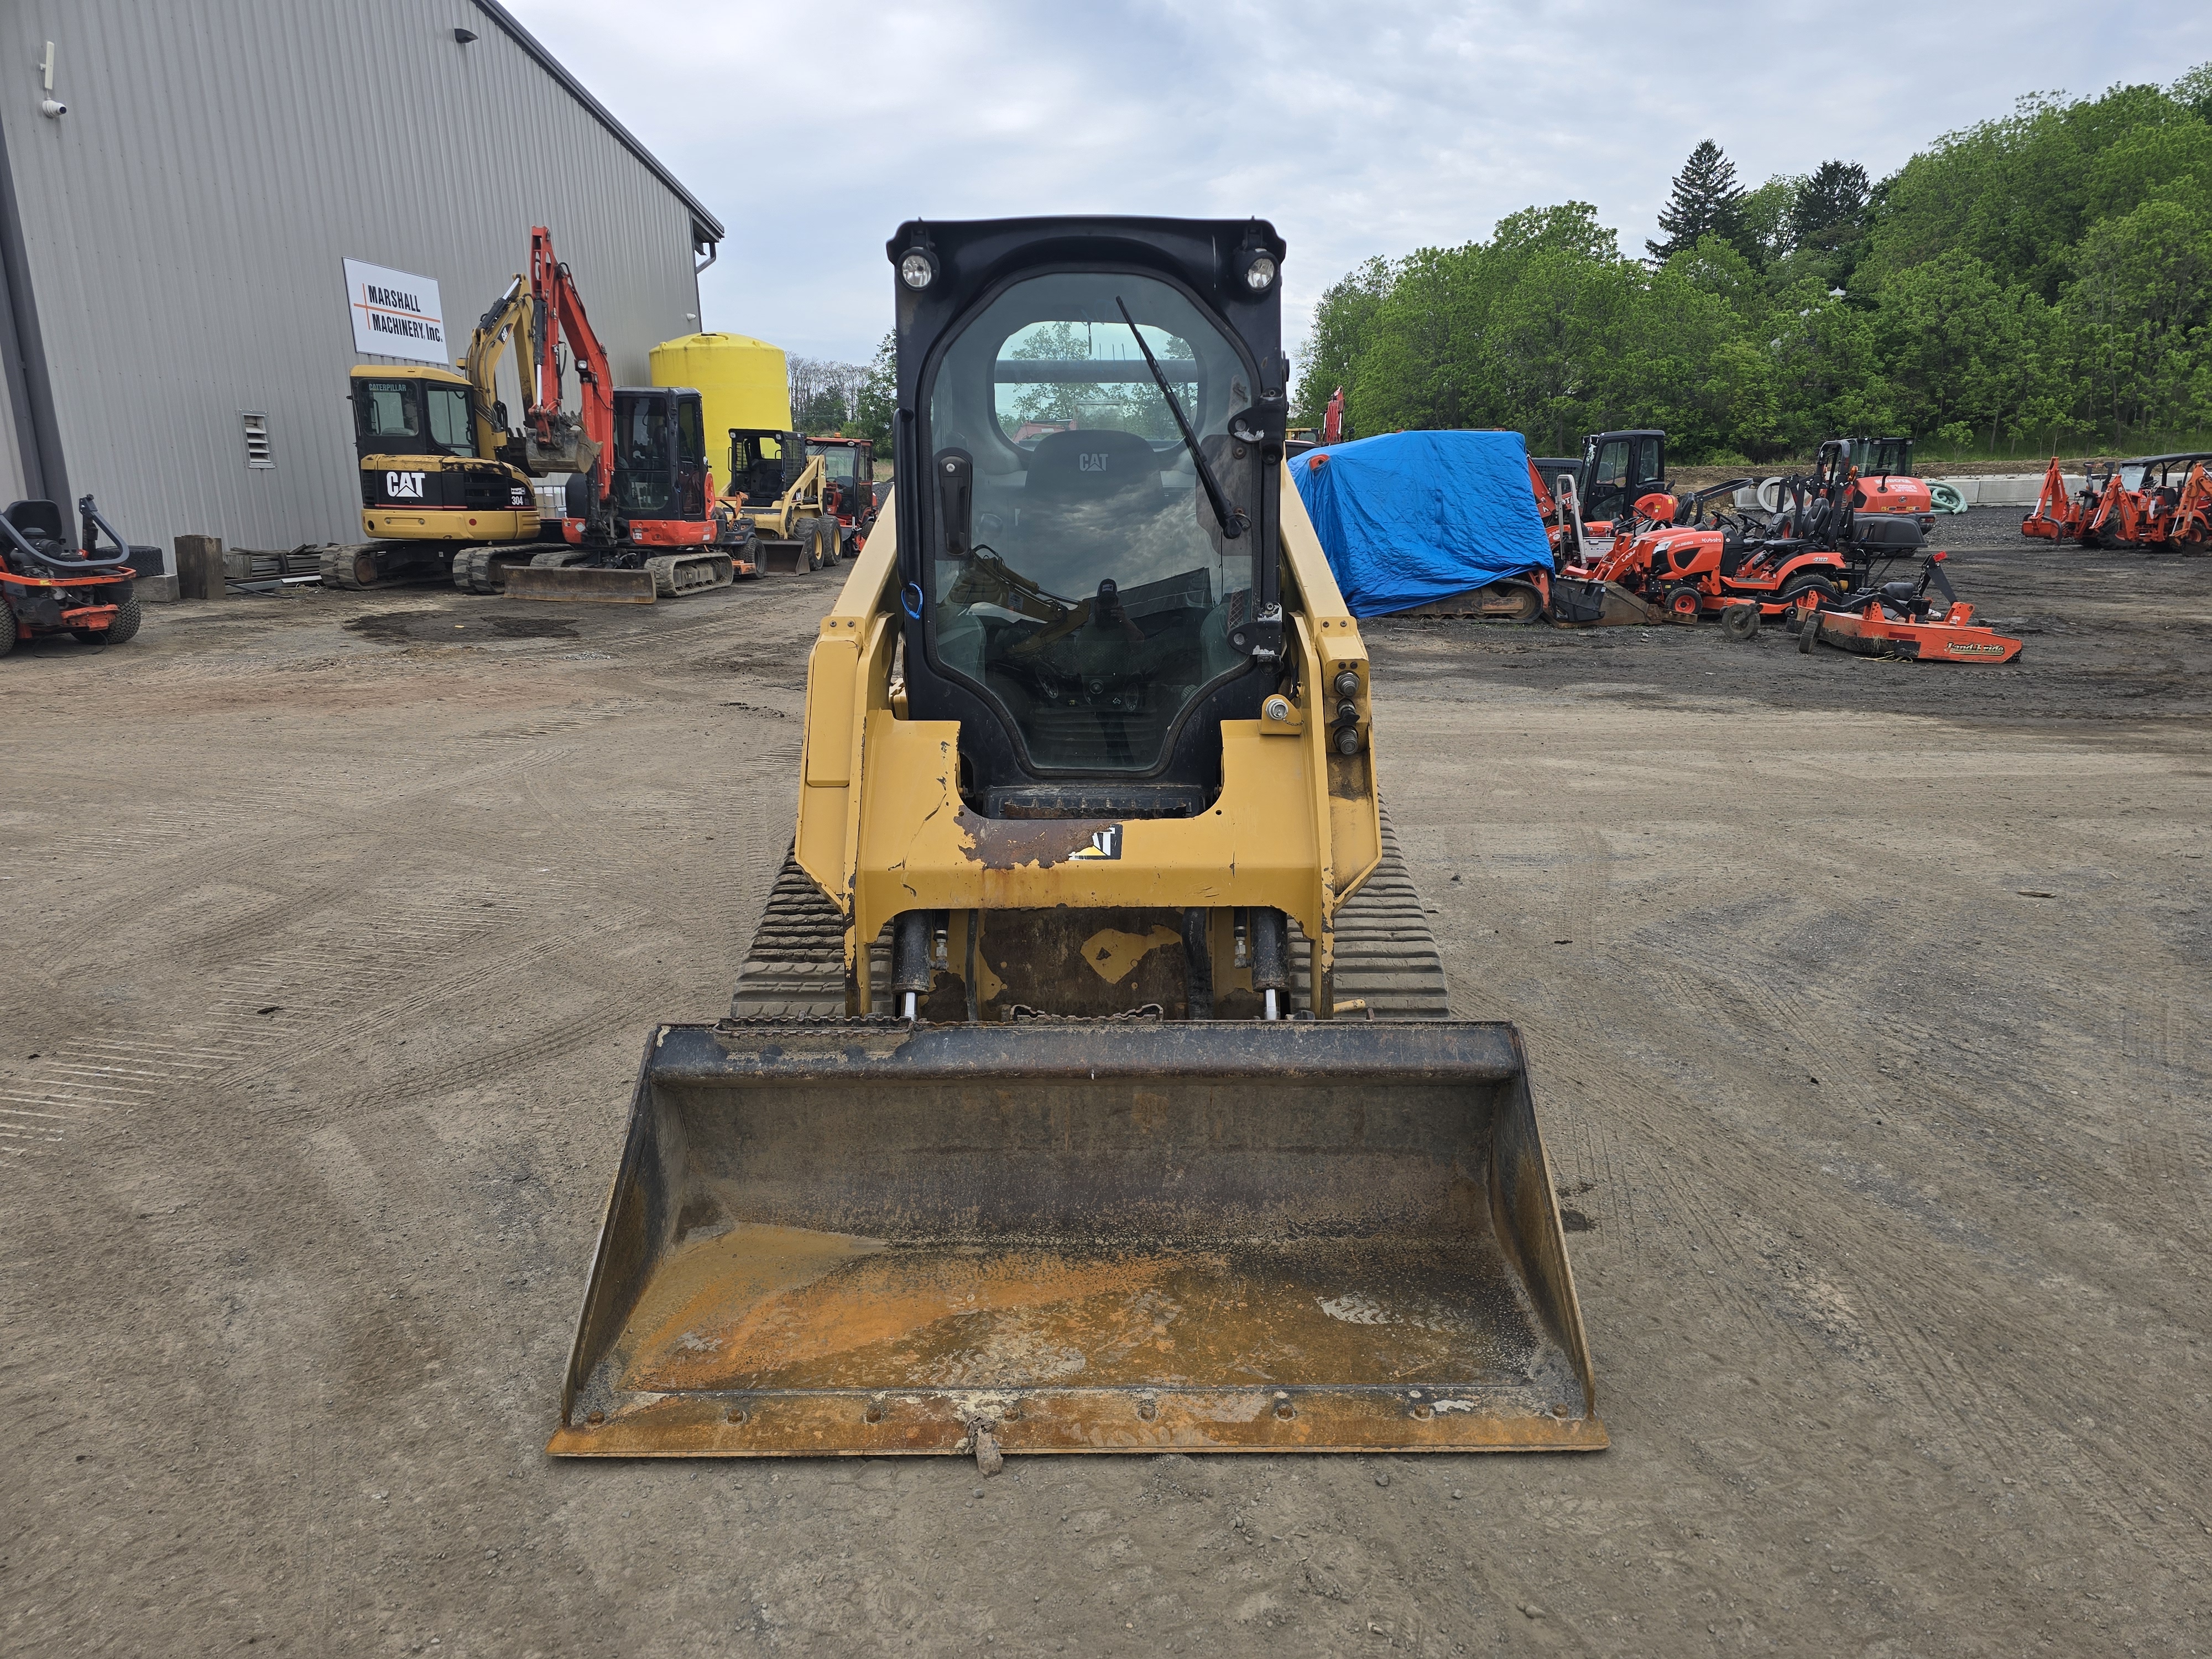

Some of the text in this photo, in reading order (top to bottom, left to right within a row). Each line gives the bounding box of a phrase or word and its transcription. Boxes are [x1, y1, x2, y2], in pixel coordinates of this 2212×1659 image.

[368, 285, 421, 312] MARSHALL
[372, 314, 443, 342] MACHINERY, Inc.
[369, 383, 406, 392] CATERPILLAR
[1079, 453, 1109, 471] CAT
[386, 471, 425, 498] CAT
[511, 495, 523, 505] 304
